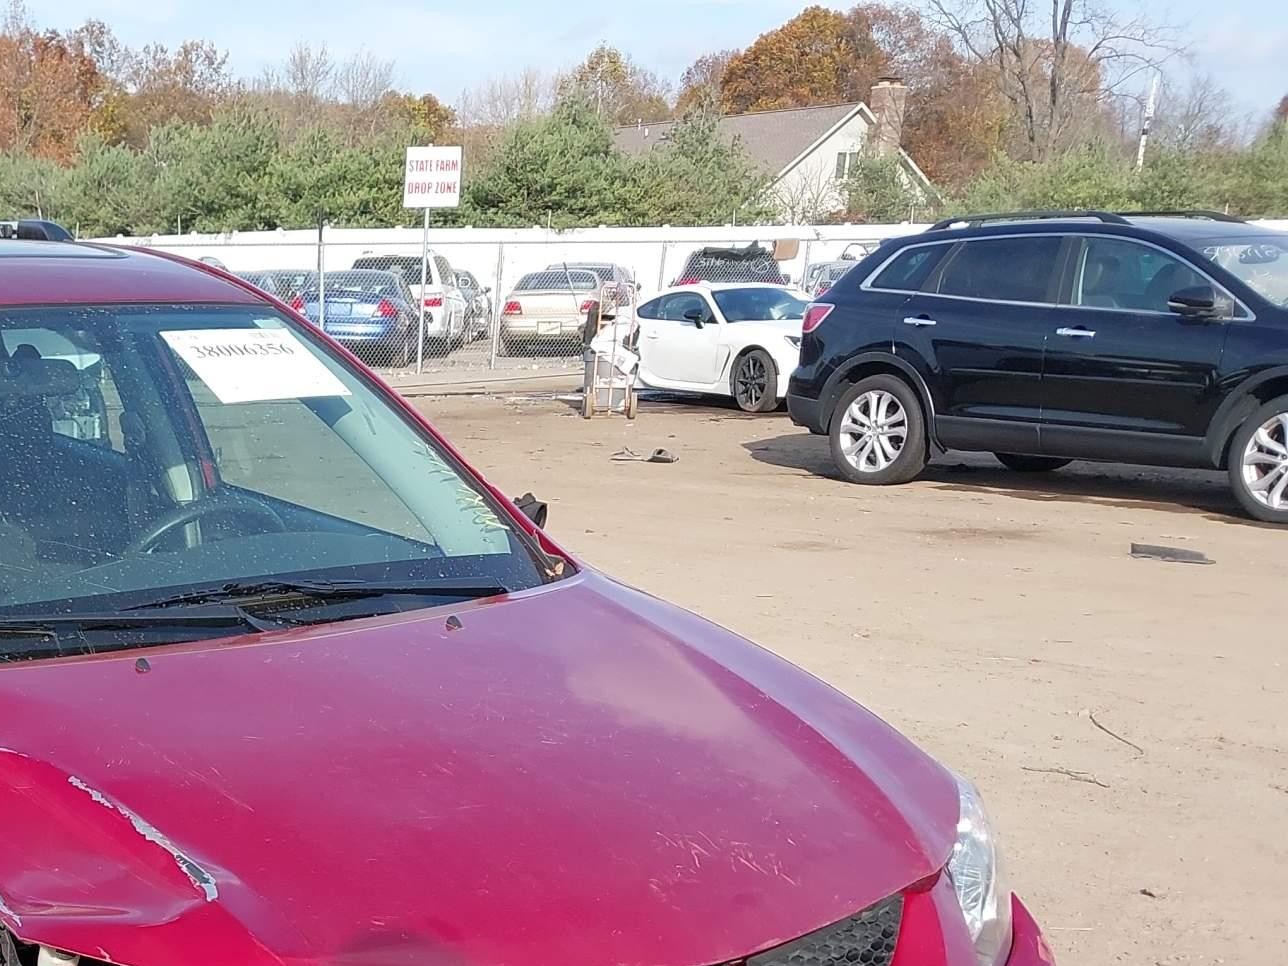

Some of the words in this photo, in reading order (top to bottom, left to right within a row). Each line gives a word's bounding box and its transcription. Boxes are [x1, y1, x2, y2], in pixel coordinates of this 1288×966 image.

[409, 159, 433, 172] STATE
[436, 159, 459, 172] FARM
[408, 182, 433, 194] DROP
[435, 182, 457, 194] ZONE
[190, 343, 295, 359] 38006356
